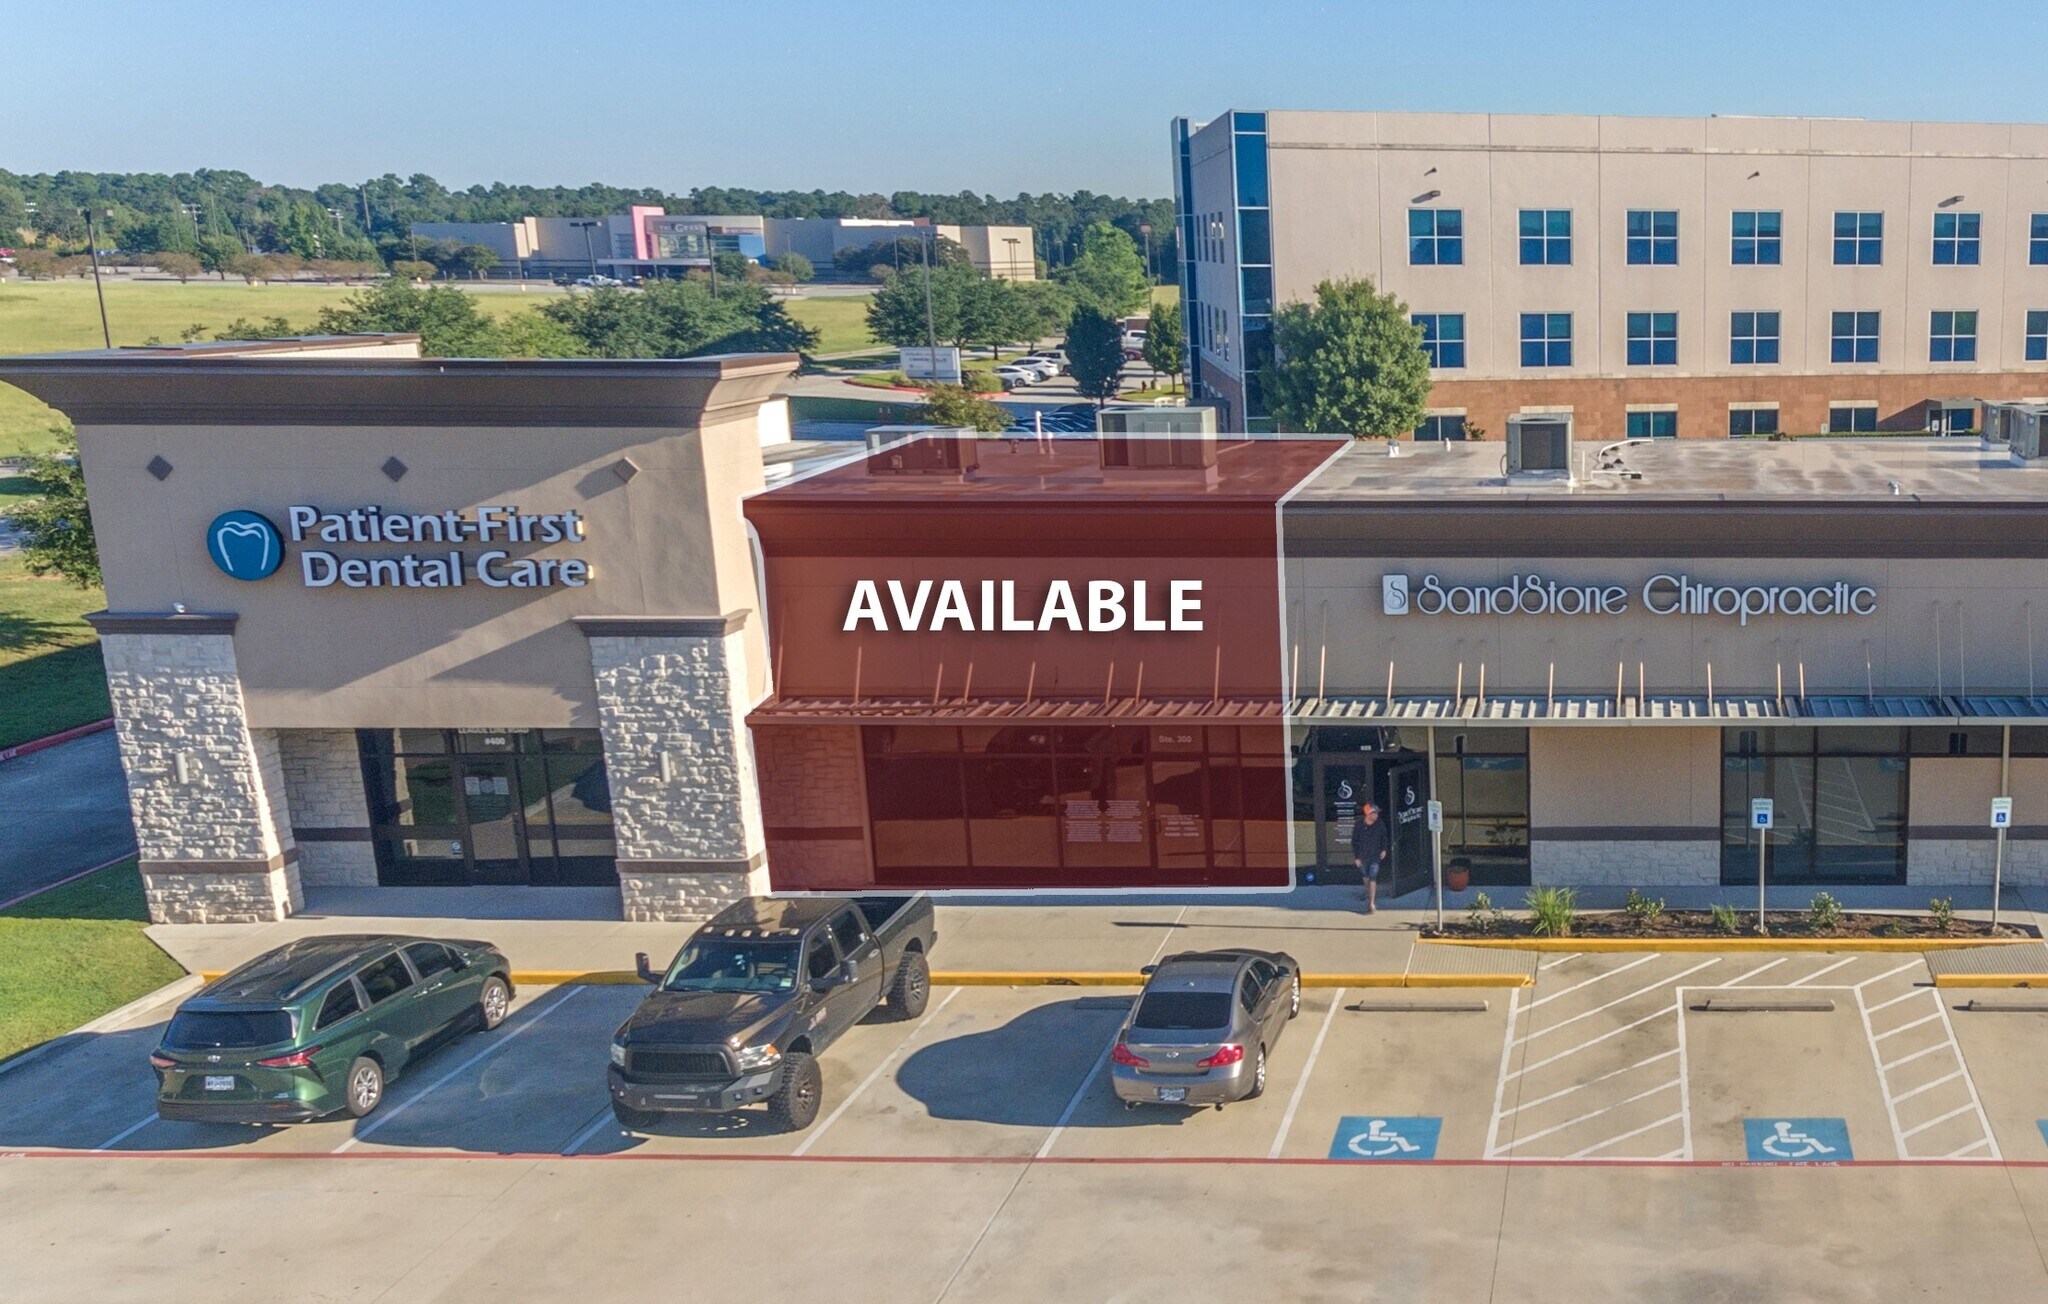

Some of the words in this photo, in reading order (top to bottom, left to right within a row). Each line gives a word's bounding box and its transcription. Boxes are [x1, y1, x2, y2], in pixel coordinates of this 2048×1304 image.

[288, 505, 585, 543] Patient-First
[301, 550, 464, 588] Dental
[476, 550, 593, 588] Care
[1416, 573, 1629, 617] SandStone
[1642, 573, 1879, 627] Chiropractic
